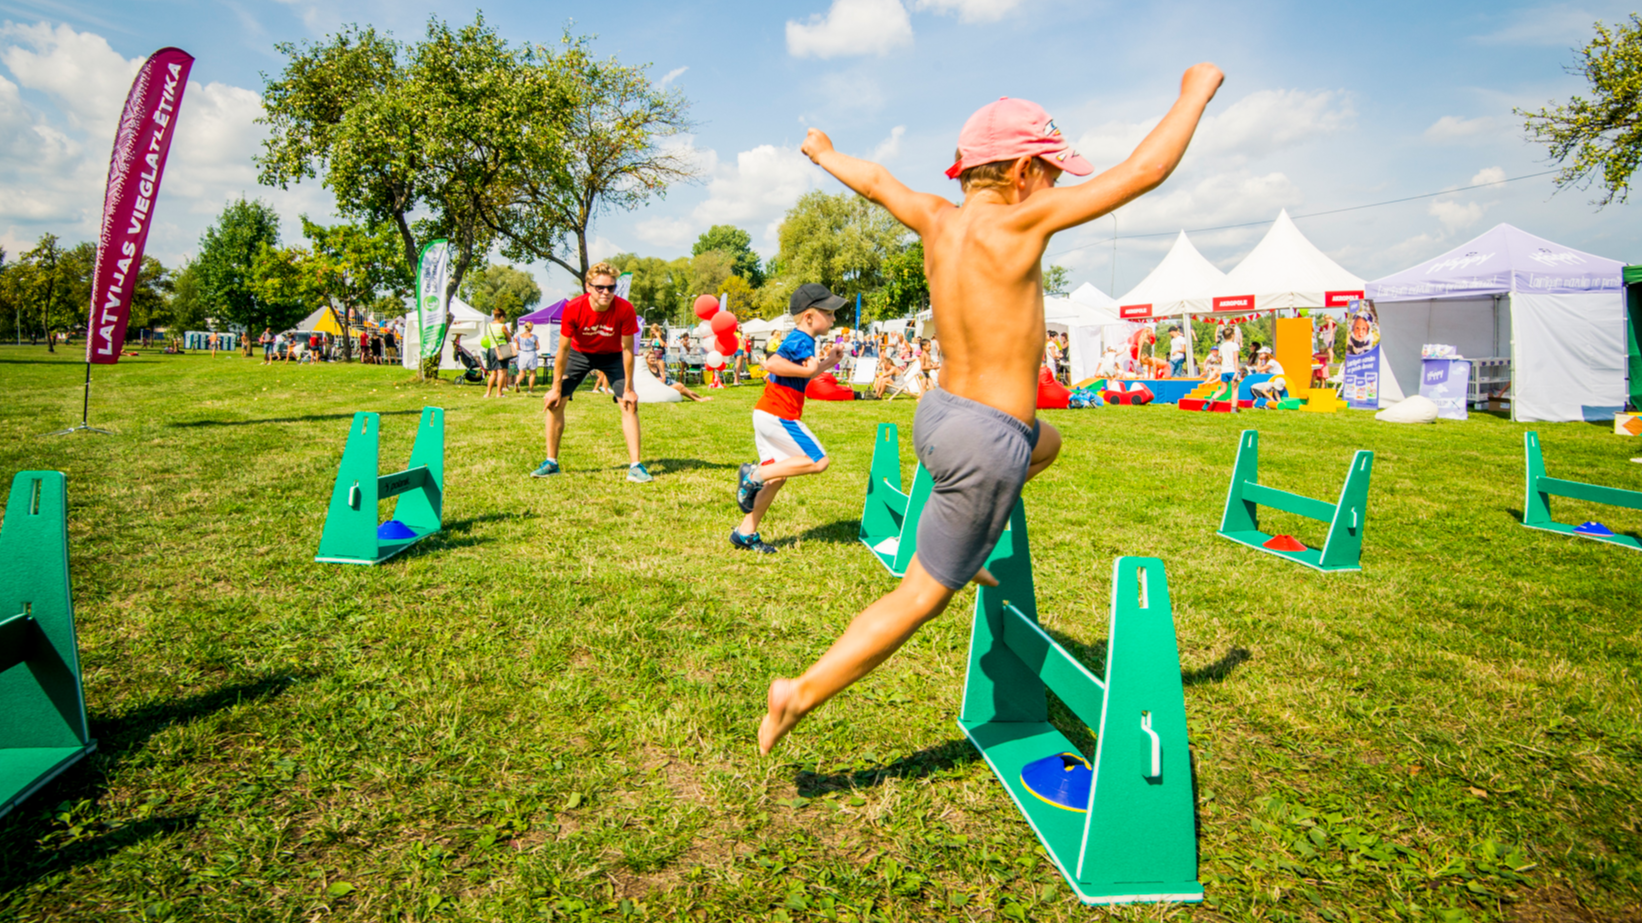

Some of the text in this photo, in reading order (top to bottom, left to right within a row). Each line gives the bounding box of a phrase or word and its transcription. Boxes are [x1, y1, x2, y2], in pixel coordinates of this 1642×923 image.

[97, 62, 182, 356] LATVIJAS VIEGLATLĒTIKA
[1219, 299, 1248, 307] AKROPOLE
